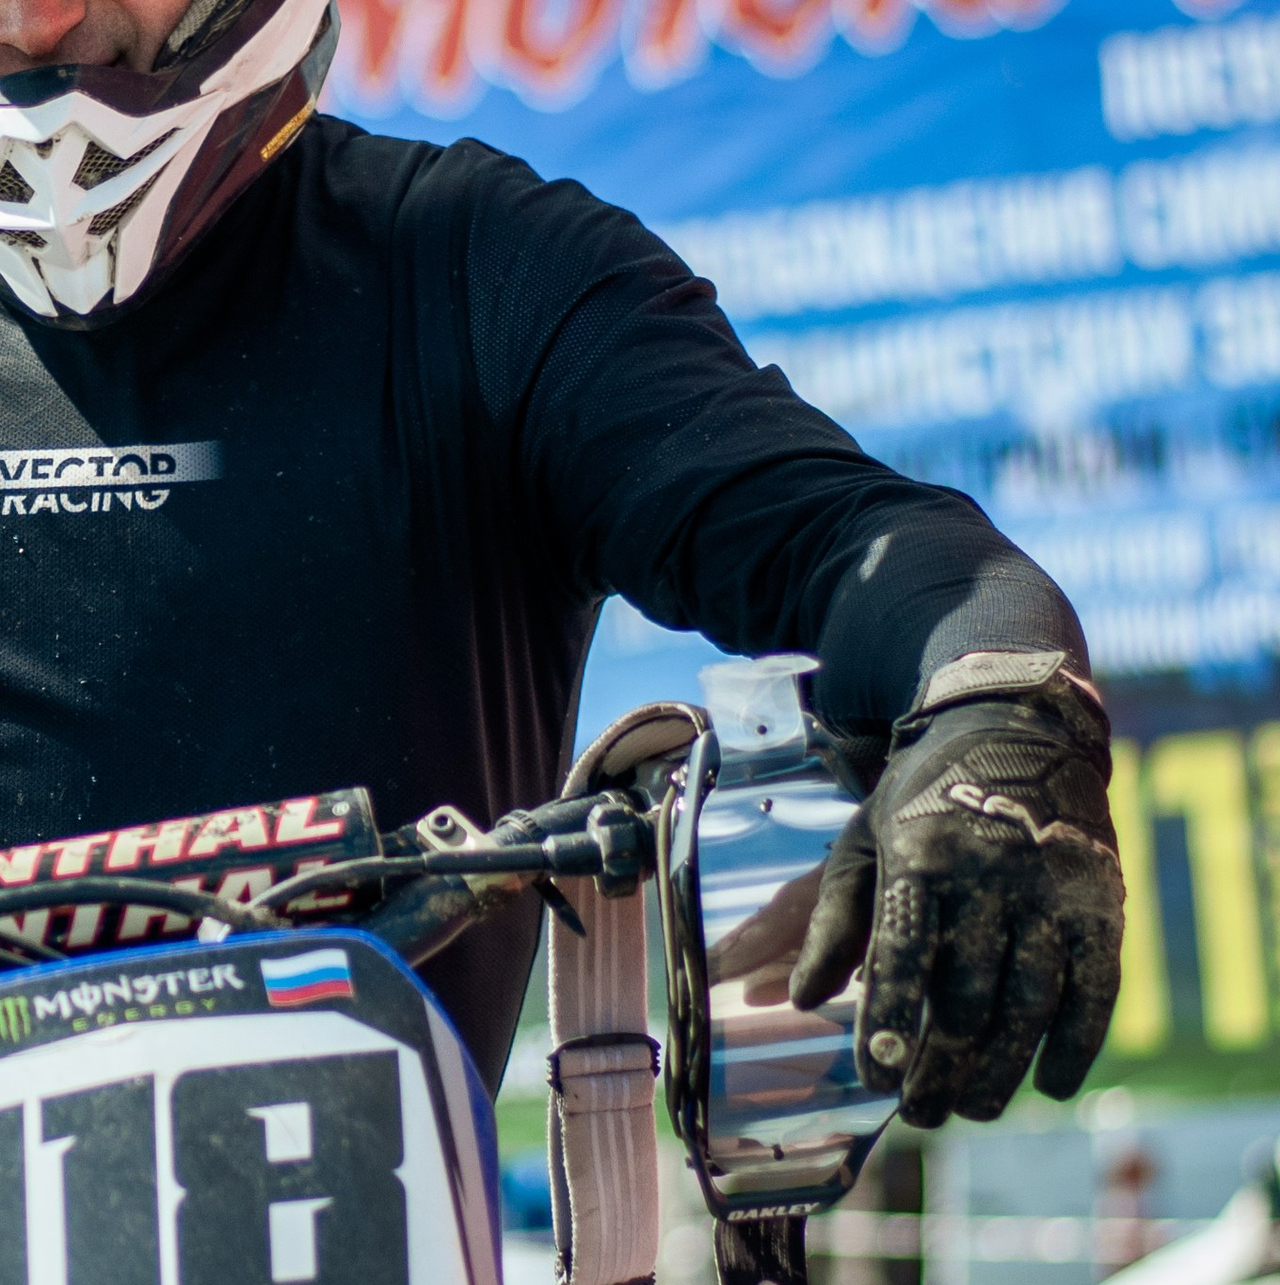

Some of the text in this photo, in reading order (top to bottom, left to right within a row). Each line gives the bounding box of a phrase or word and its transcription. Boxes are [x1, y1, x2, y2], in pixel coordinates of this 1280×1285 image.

[1, 489, 171, 516] RACING
[32, 963, 245, 1021] MONSTER
[72, 996, 217, 1033] ENERGY
[726, 1201, 820, 1222] OAKLEY
